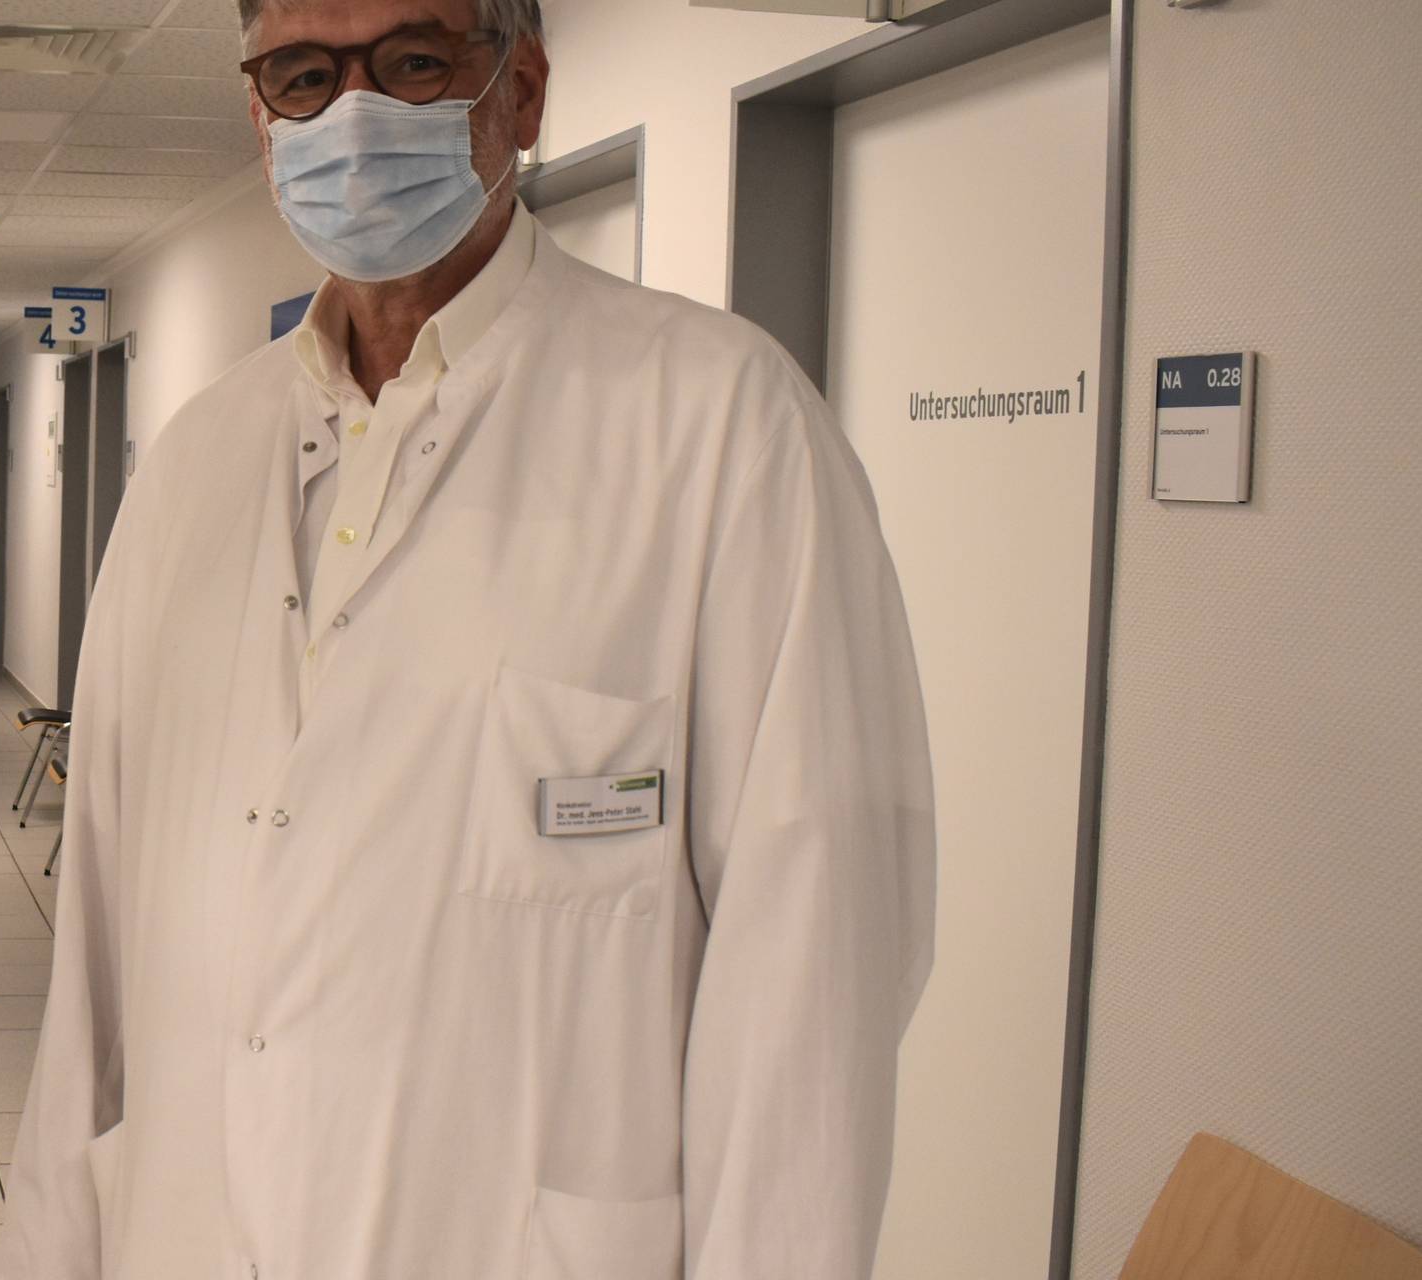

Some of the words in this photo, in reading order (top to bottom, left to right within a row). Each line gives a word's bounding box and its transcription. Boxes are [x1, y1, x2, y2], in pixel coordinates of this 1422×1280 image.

[68, 305, 86, 335] 3
[39, 323, 56, 349] 4
[1161, 371, 1182, 390] NA
[1207, 367, 1241, 388] 0.28
[909, 387, 1071, 424] Untersuchungsraum
[1076, 370, 1086, 414] 1
